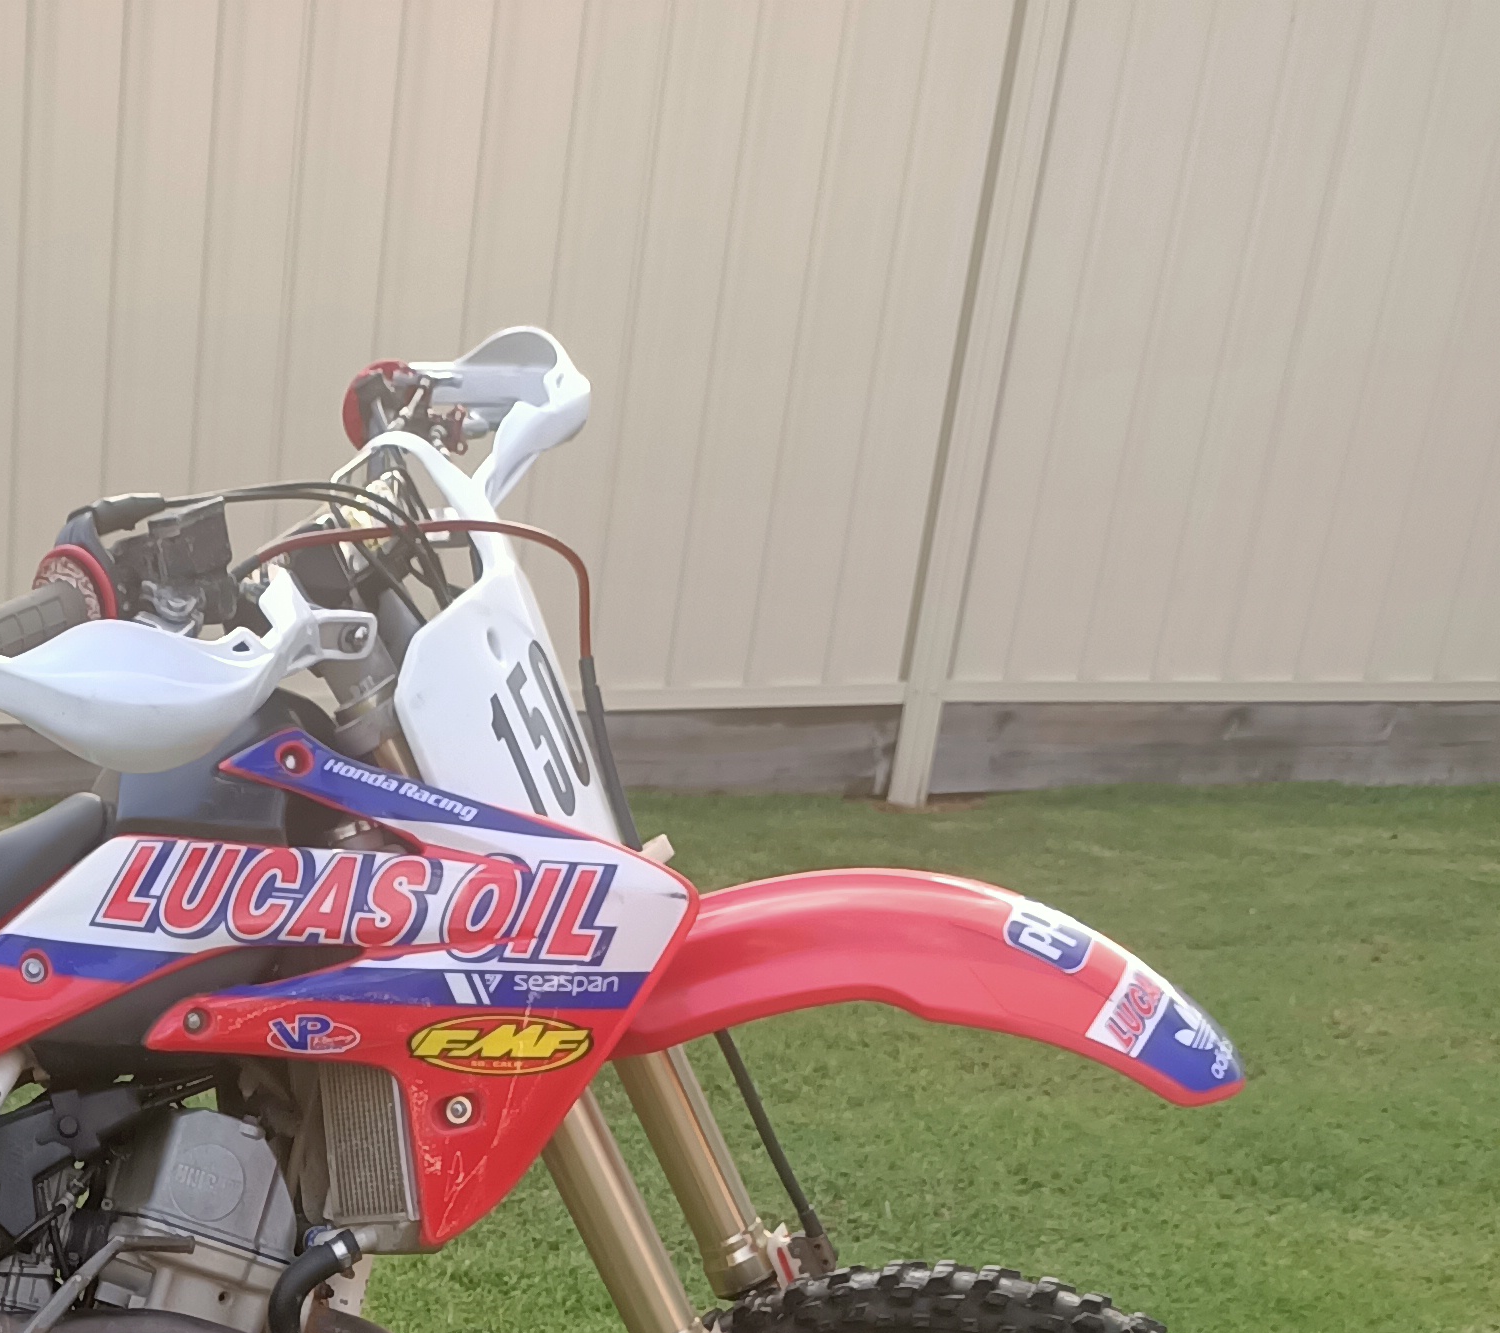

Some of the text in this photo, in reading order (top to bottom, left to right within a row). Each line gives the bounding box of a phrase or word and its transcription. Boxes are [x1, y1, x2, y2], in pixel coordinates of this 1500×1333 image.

[490, 640, 591, 817] 150
[324, 757, 480, 822] Honda Racing
[90, 838, 618, 966] LUCAS OIL
[513, 973, 620, 997] seaspan
[268, 1013, 334, 1051] VP
[411, 1023, 593, 1059] FMF
